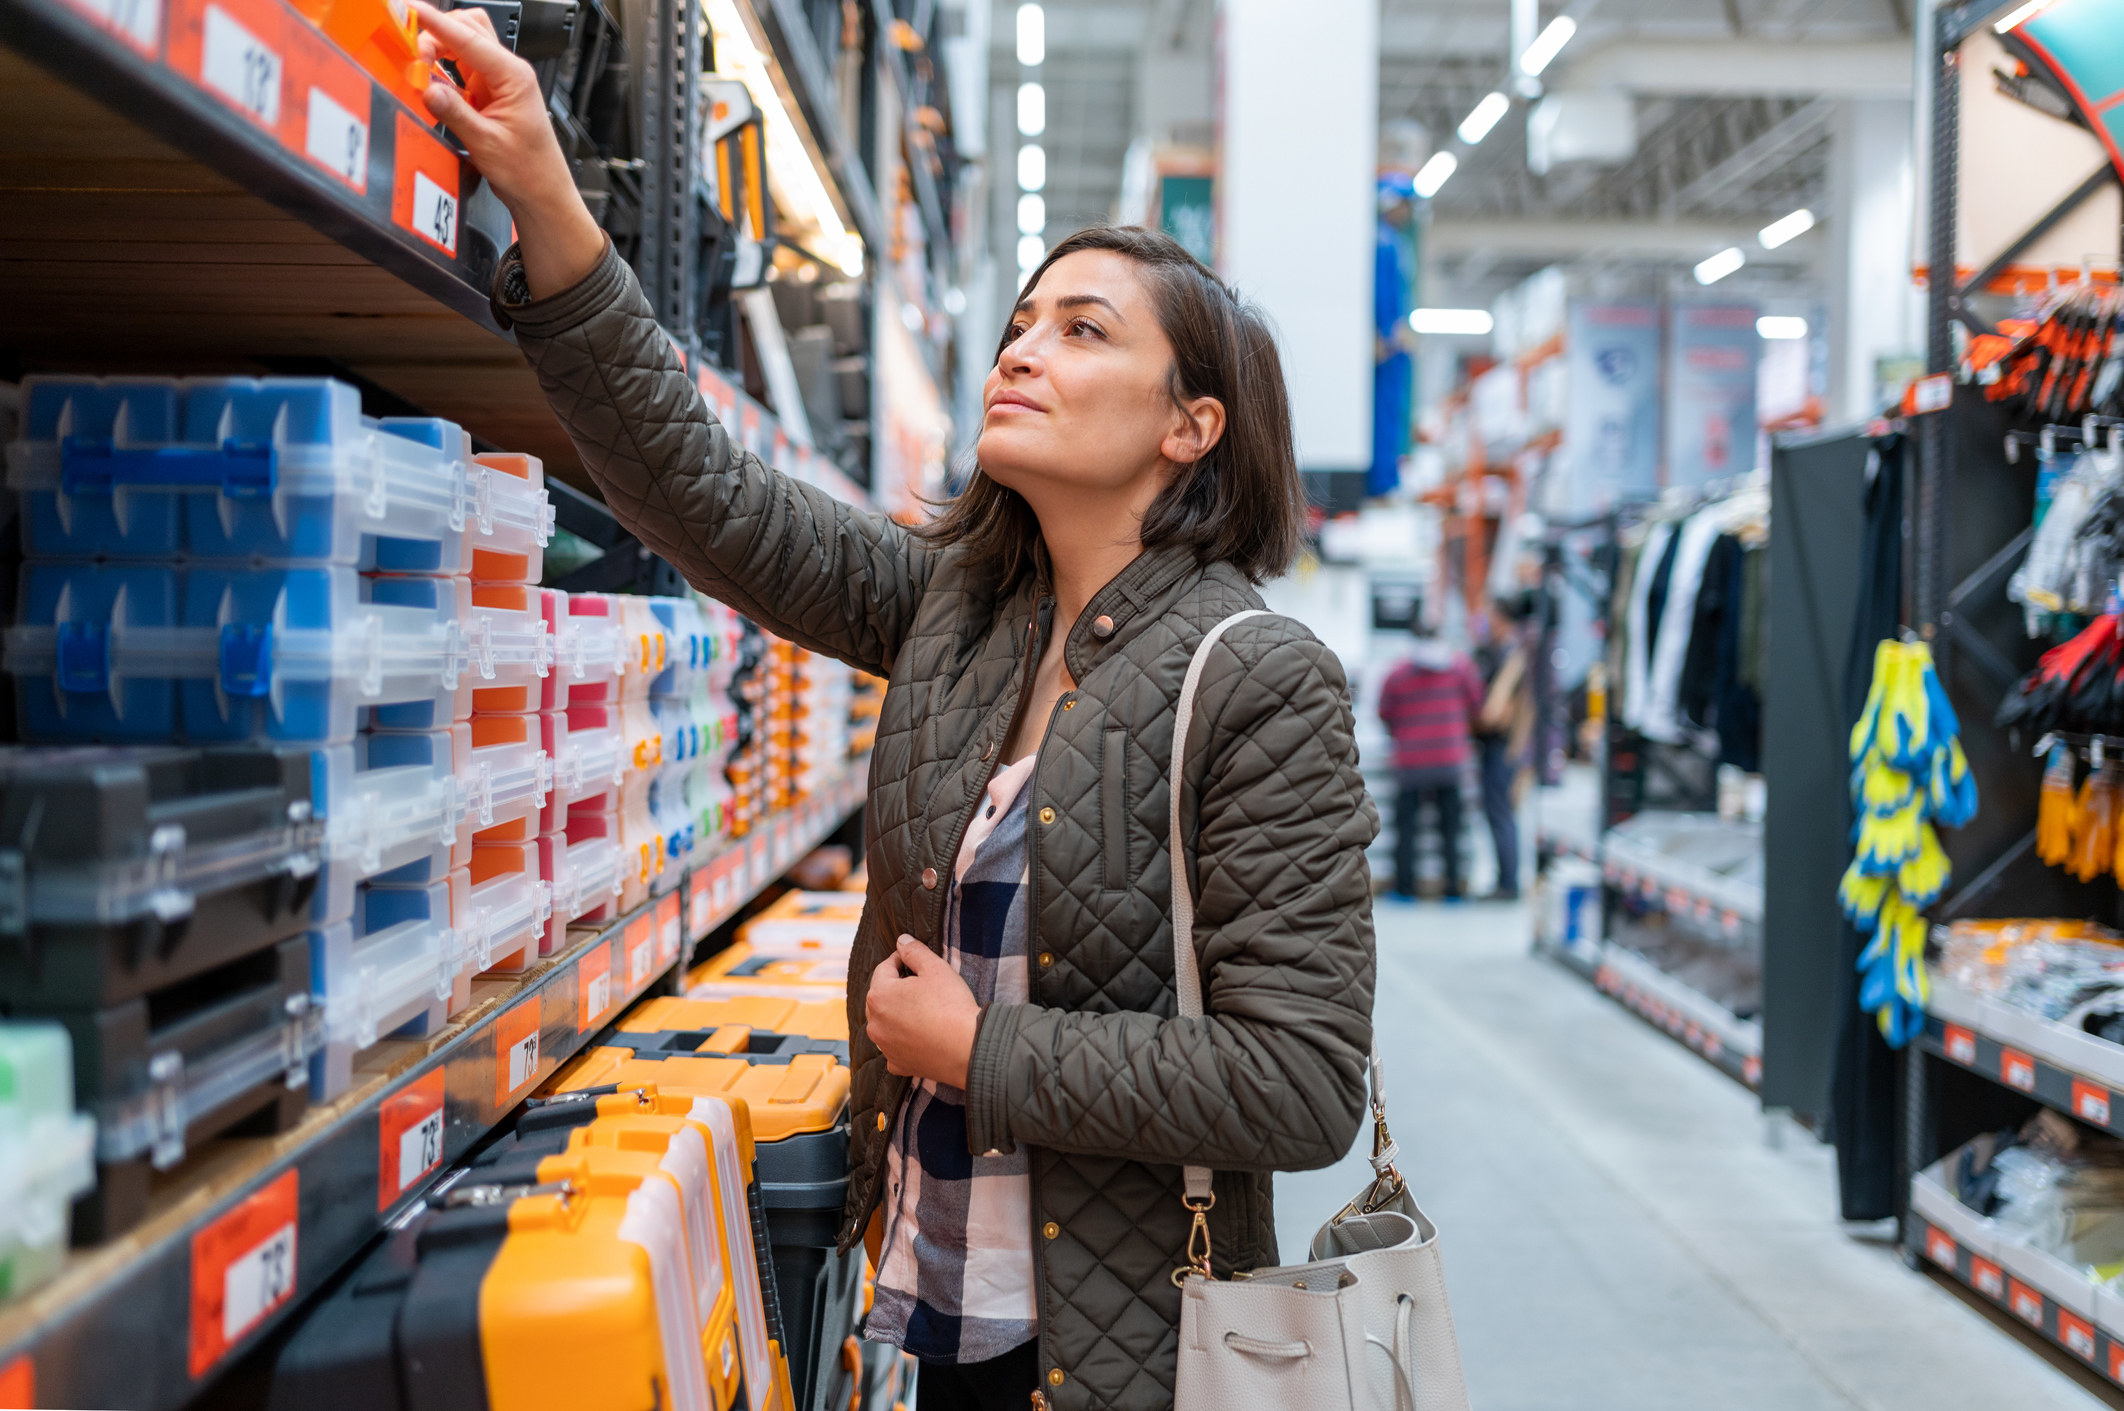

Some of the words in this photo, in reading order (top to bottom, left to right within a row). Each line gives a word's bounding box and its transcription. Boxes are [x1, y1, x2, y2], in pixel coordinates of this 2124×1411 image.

[433, 194, 451, 245] 43
[523, 1037, 535, 1081] 73
[421, 1119, 436, 1172] 73
